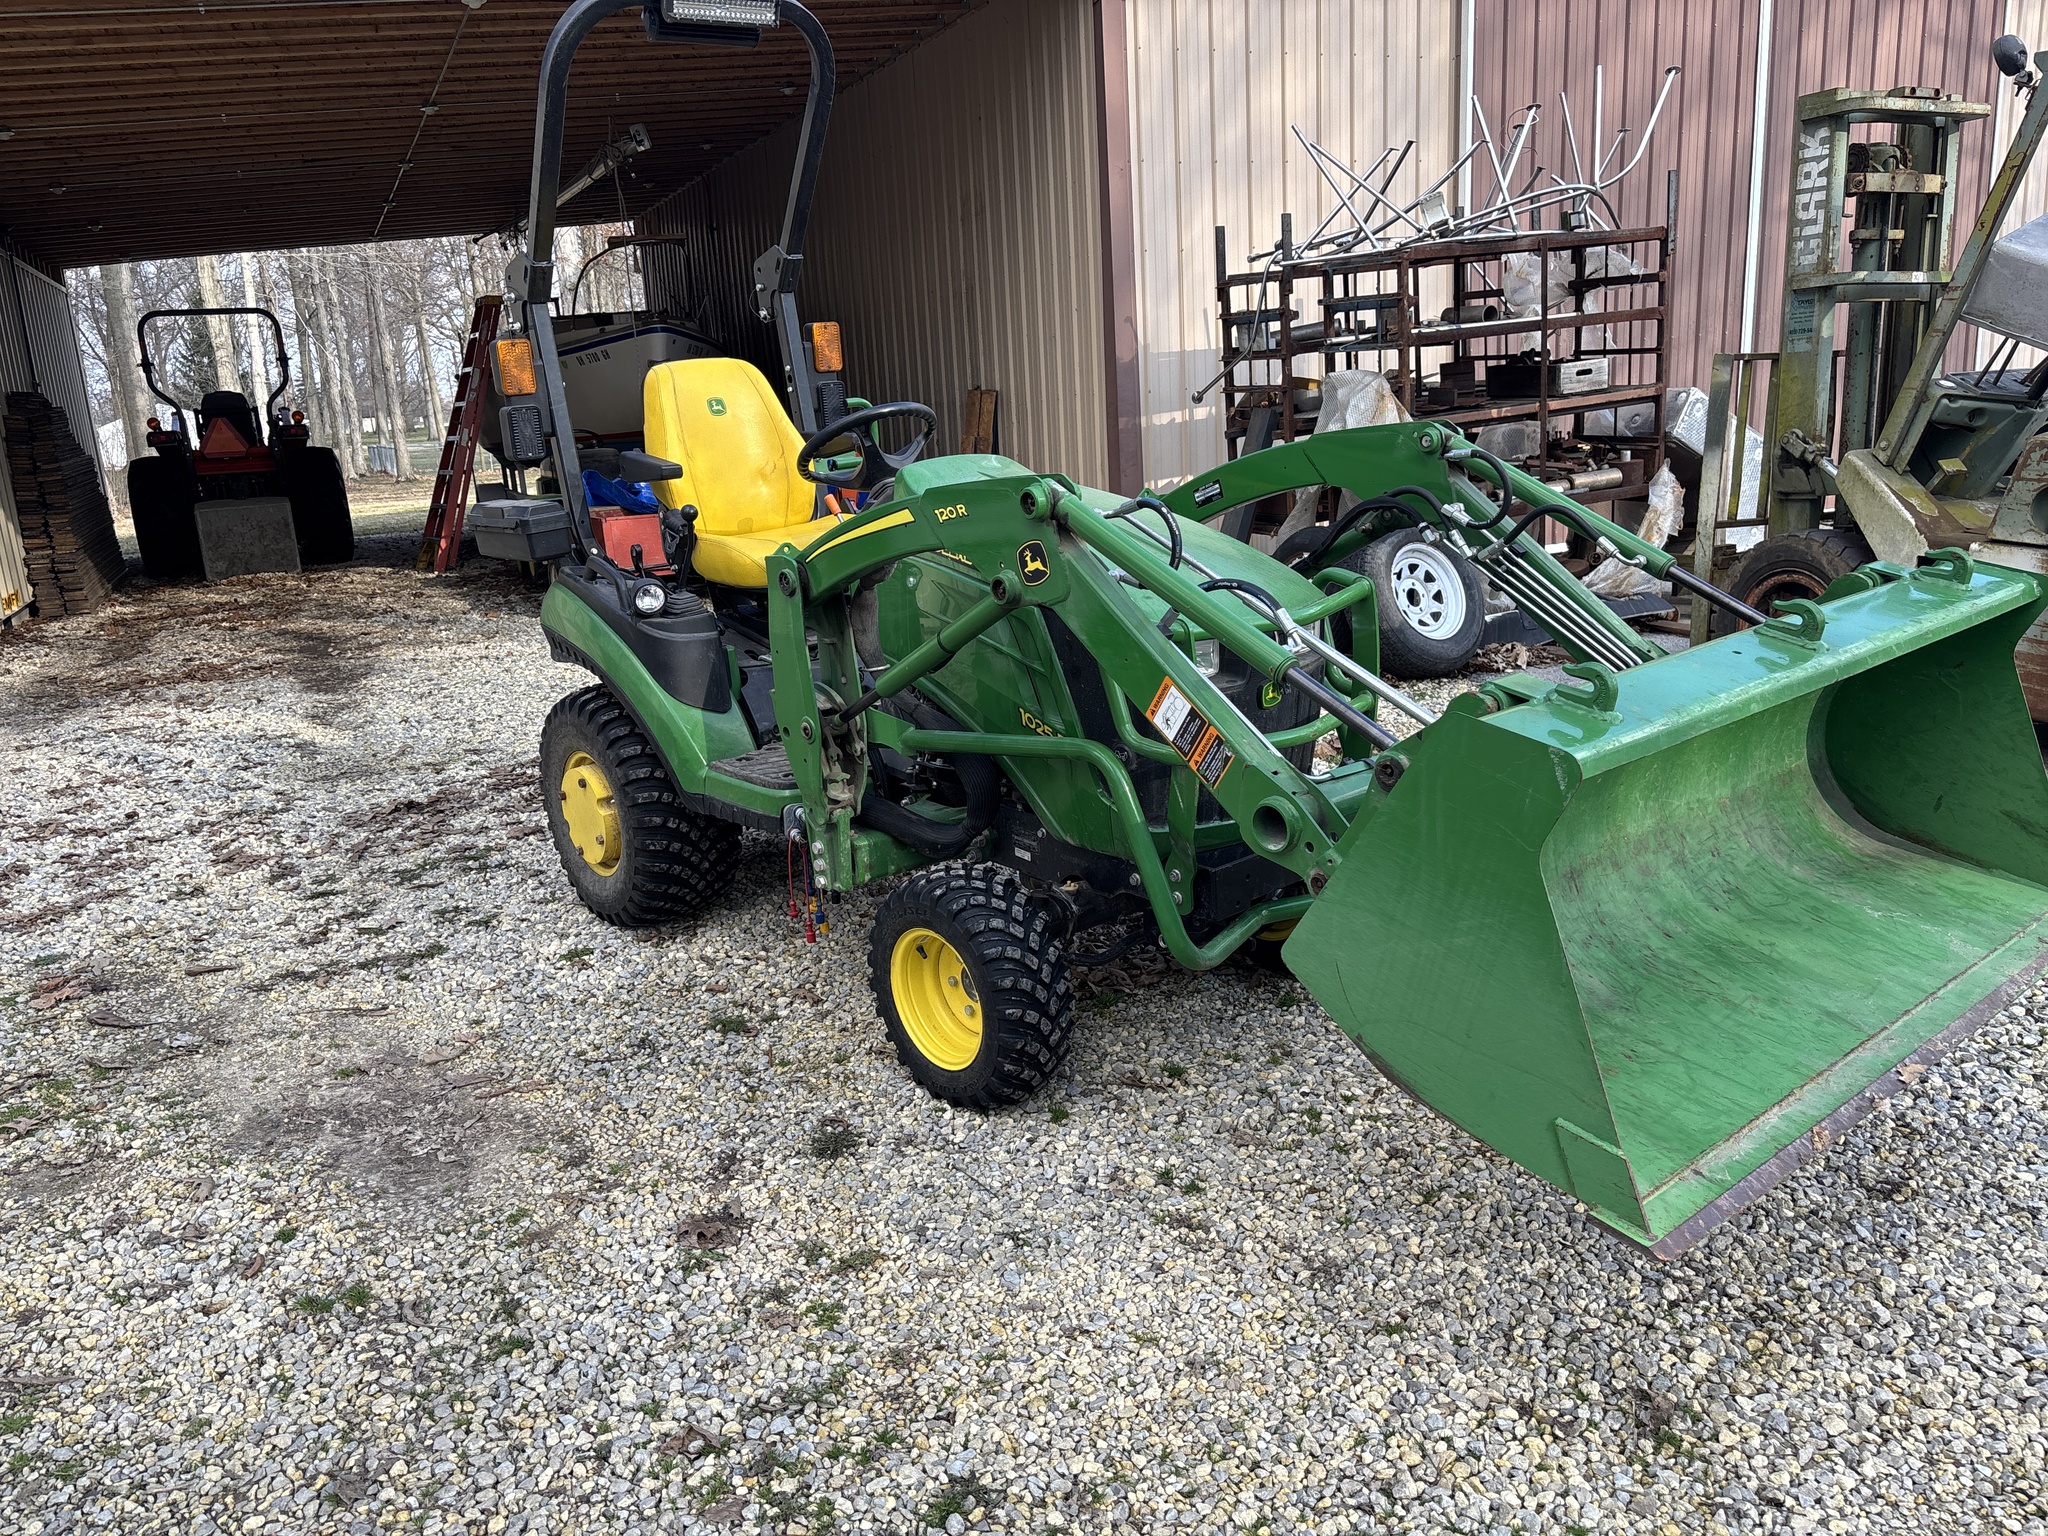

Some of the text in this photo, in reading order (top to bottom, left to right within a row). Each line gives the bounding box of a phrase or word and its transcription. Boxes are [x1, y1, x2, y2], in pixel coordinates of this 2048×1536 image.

[1793, 126, 1830, 266] CLARK
[1154, 683, 1170, 709] WARNING
[1018, 706, 1064, 737] 1025
[1198, 732, 1215, 759] WARNING
